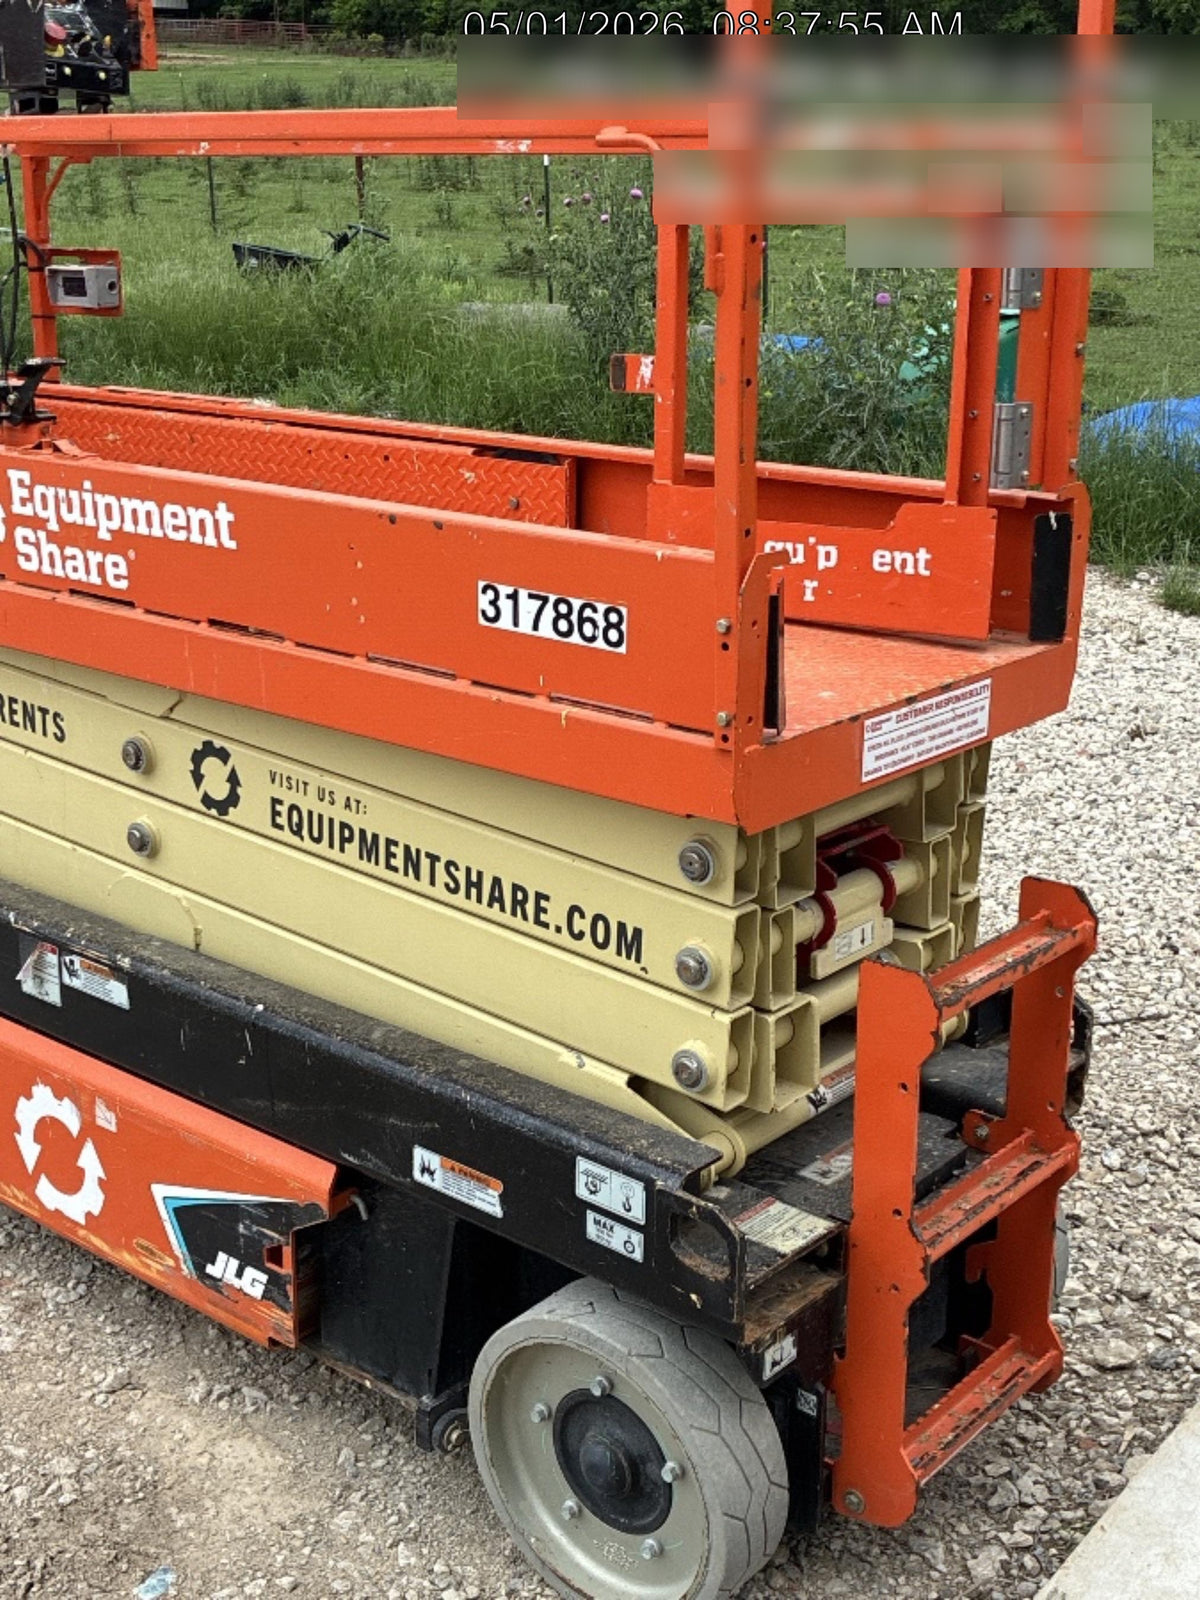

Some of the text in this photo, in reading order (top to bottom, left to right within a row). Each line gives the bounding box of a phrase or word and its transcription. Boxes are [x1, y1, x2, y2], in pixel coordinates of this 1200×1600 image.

[7, 469, 237, 549] Equipment
[14, 526, 129, 590] Share
[481, 583, 624, 648] 317868
[269, 769, 367, 816] VISIT US AT:
[269, 796, 643, 965] EQUIPMENTSHARE.COM
[205, 1251, 269, 1300] JLG
